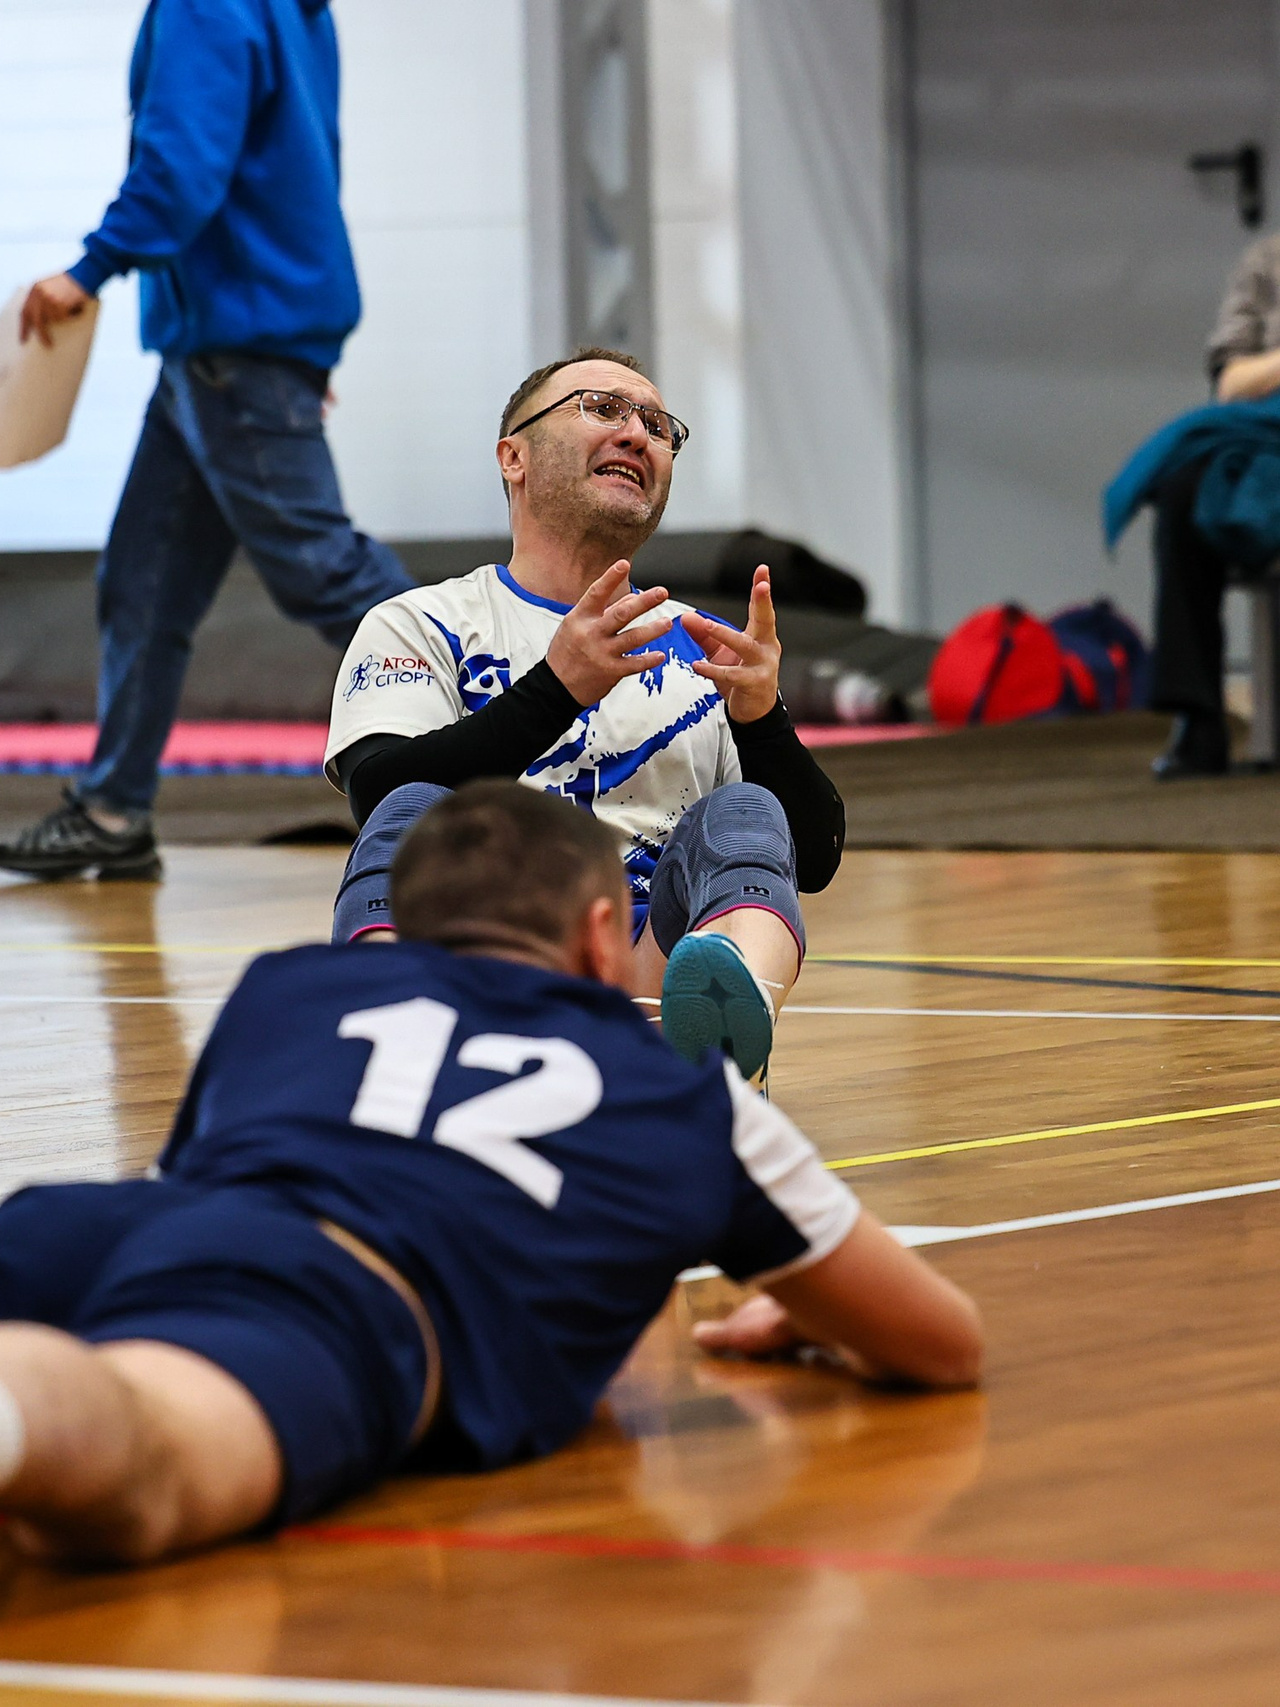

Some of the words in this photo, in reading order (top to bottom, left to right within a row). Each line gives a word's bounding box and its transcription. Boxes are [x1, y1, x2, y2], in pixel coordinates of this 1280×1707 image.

[382, 657, 432, 672] АТОМ
[375, 671, 435, 687] СПОРТ
[336, 996, 604, 1210] 12
